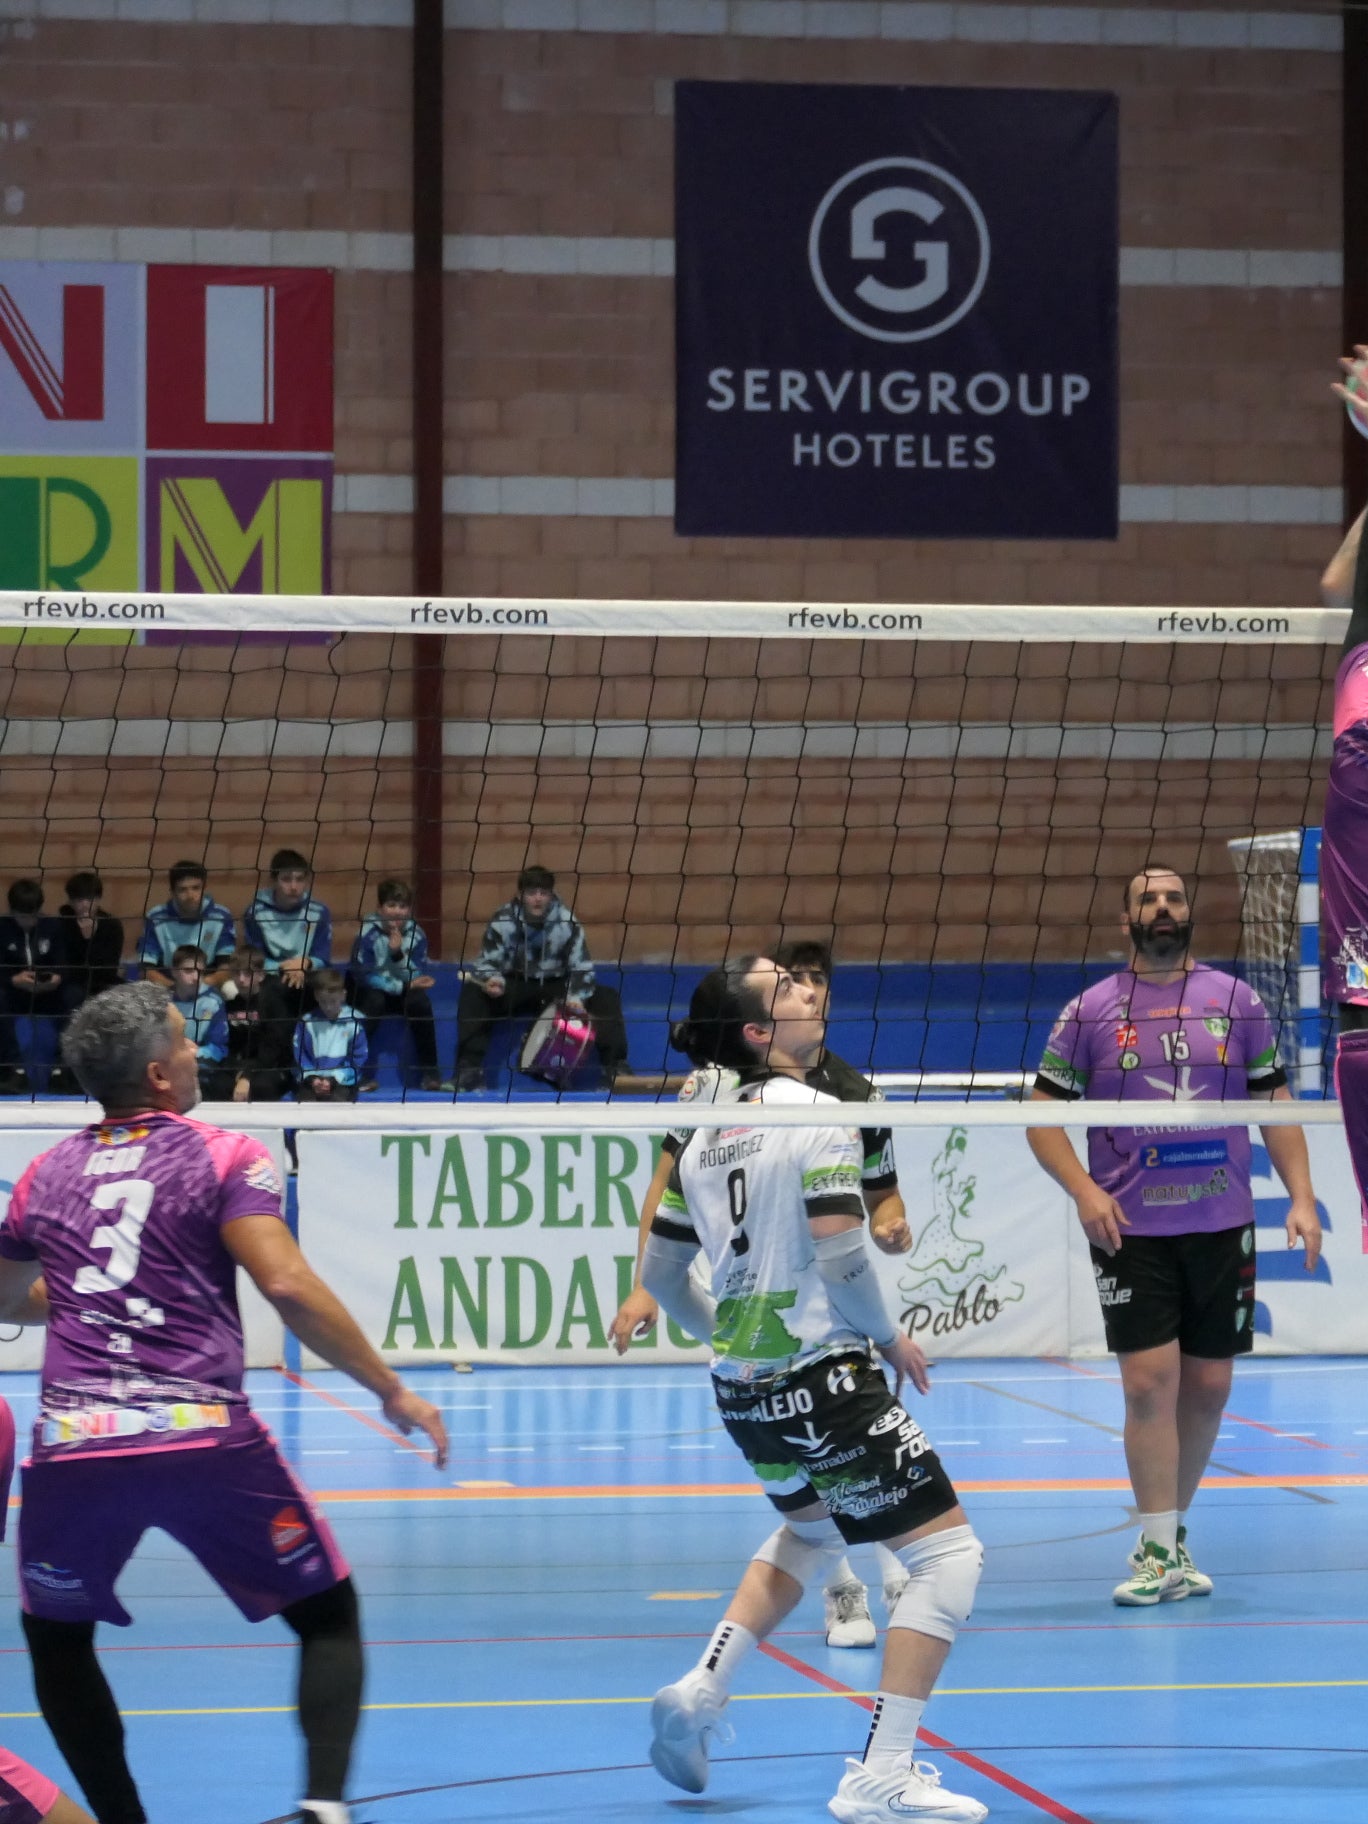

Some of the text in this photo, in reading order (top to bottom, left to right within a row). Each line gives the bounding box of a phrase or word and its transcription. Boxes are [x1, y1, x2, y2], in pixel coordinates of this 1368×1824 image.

[706, 368, 1091, 417] SERVIGROUP
[793, 433, 996, 470] HOTELES
[23, 596, 165, 621] rfevb.com
[410, 602, 549, 627] rfevb.com
[787, 607, 923, 631] rfevb.com
[1156, 611, 1290, 635] rfevb.com
[1158, 1030, 1191, 1063] 15
[381, 1133, 664, 1229] TABER
[727, 1168, 750, 1258] 9
[72, 1179, 155, 1294] 3
[381, 1255, 706, 1350] ANDAL
[899, 1283, 1004, 1340] Pablo
